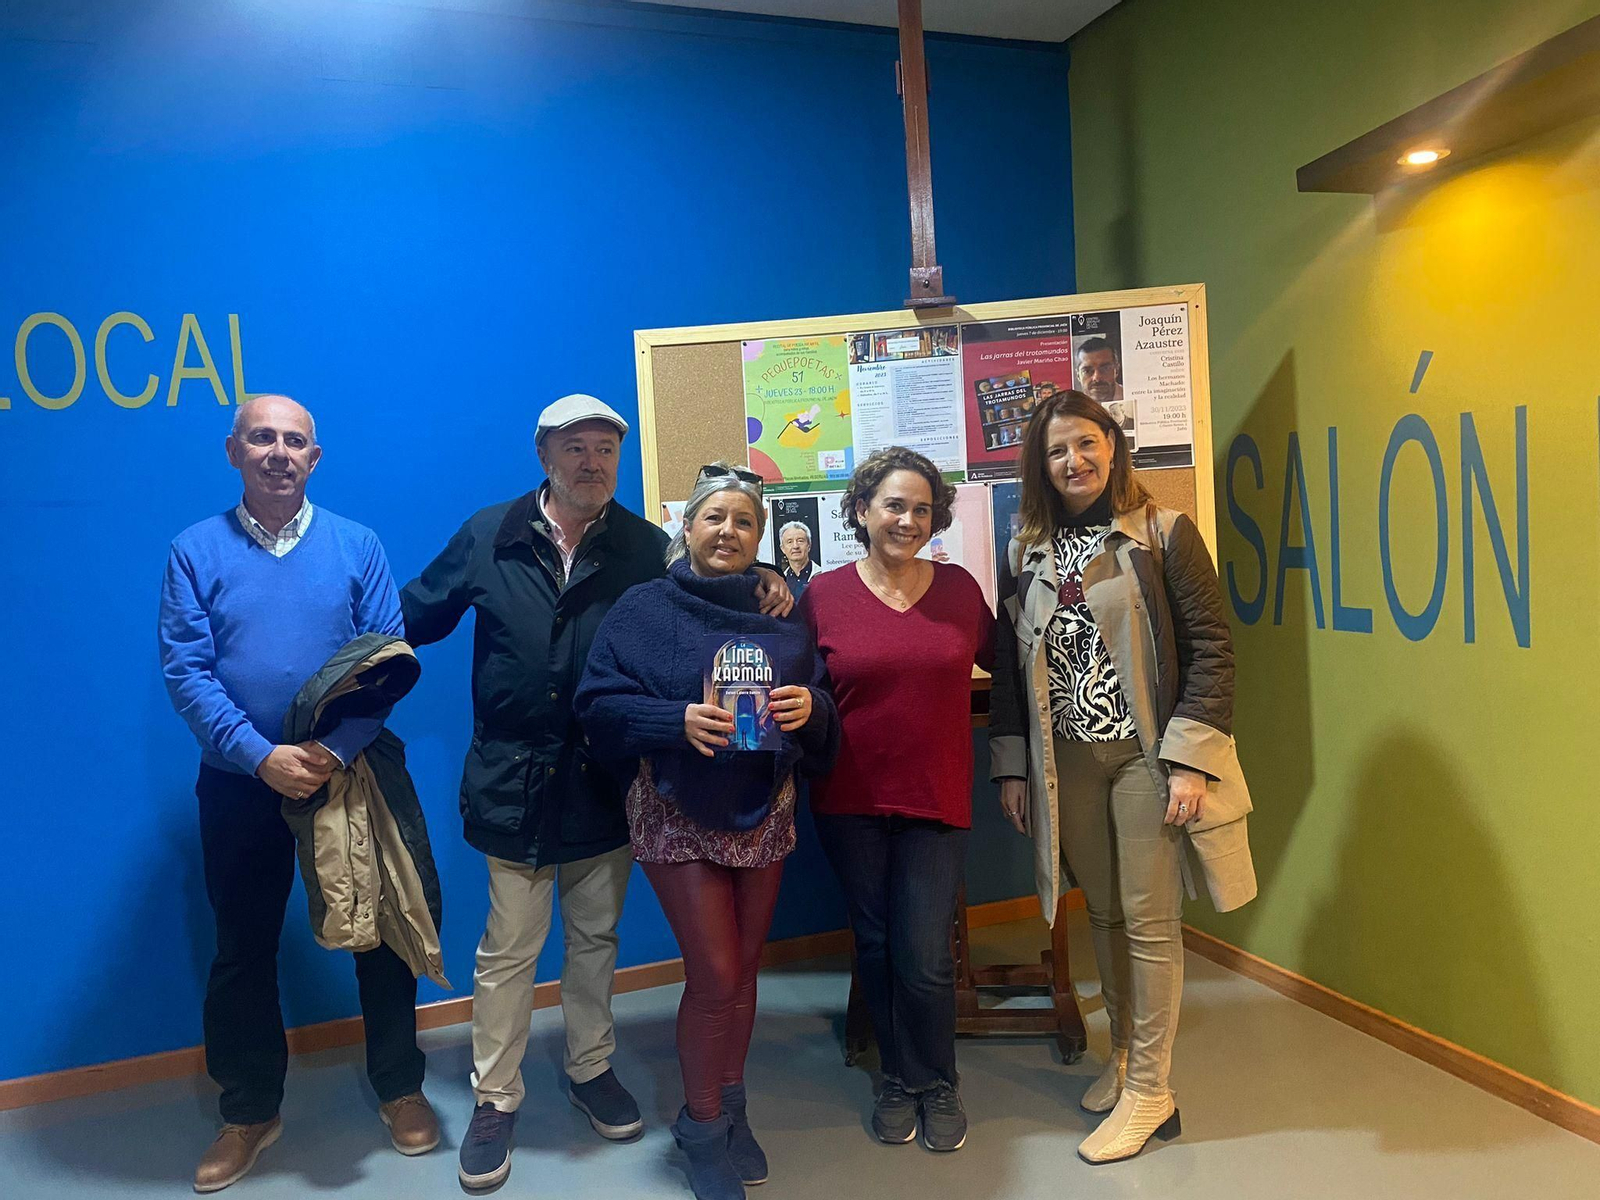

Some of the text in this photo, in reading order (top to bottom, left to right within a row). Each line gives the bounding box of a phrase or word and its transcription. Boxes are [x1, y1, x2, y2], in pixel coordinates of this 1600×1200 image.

[1138, 313, 1182, 327] Joaquín
[1152, 326, 1183, 337] Pérez
[1135, 339, 1184, 351] Azaustre
[0, 312, 271, 410] OCAL
[980, 348, 1068, 361] Las jarras del trotamundos
[761, 356, 835, 383] PEQUEPOETAS
[857, 364, 886, 373] Noviembre
[791, 370, 804, 383] 51
[764, 387, 793, 398] JUEVES
[994, 390, 1015, 399] JARRAS
[985, 393, 1027, 406] TROTAMUNDOS
[1151, 405, 1186, 414] 30/11/2023
[1226, 350, 1531, 649] SALÓN
[722, 645, 764, 663] LÍNEA
